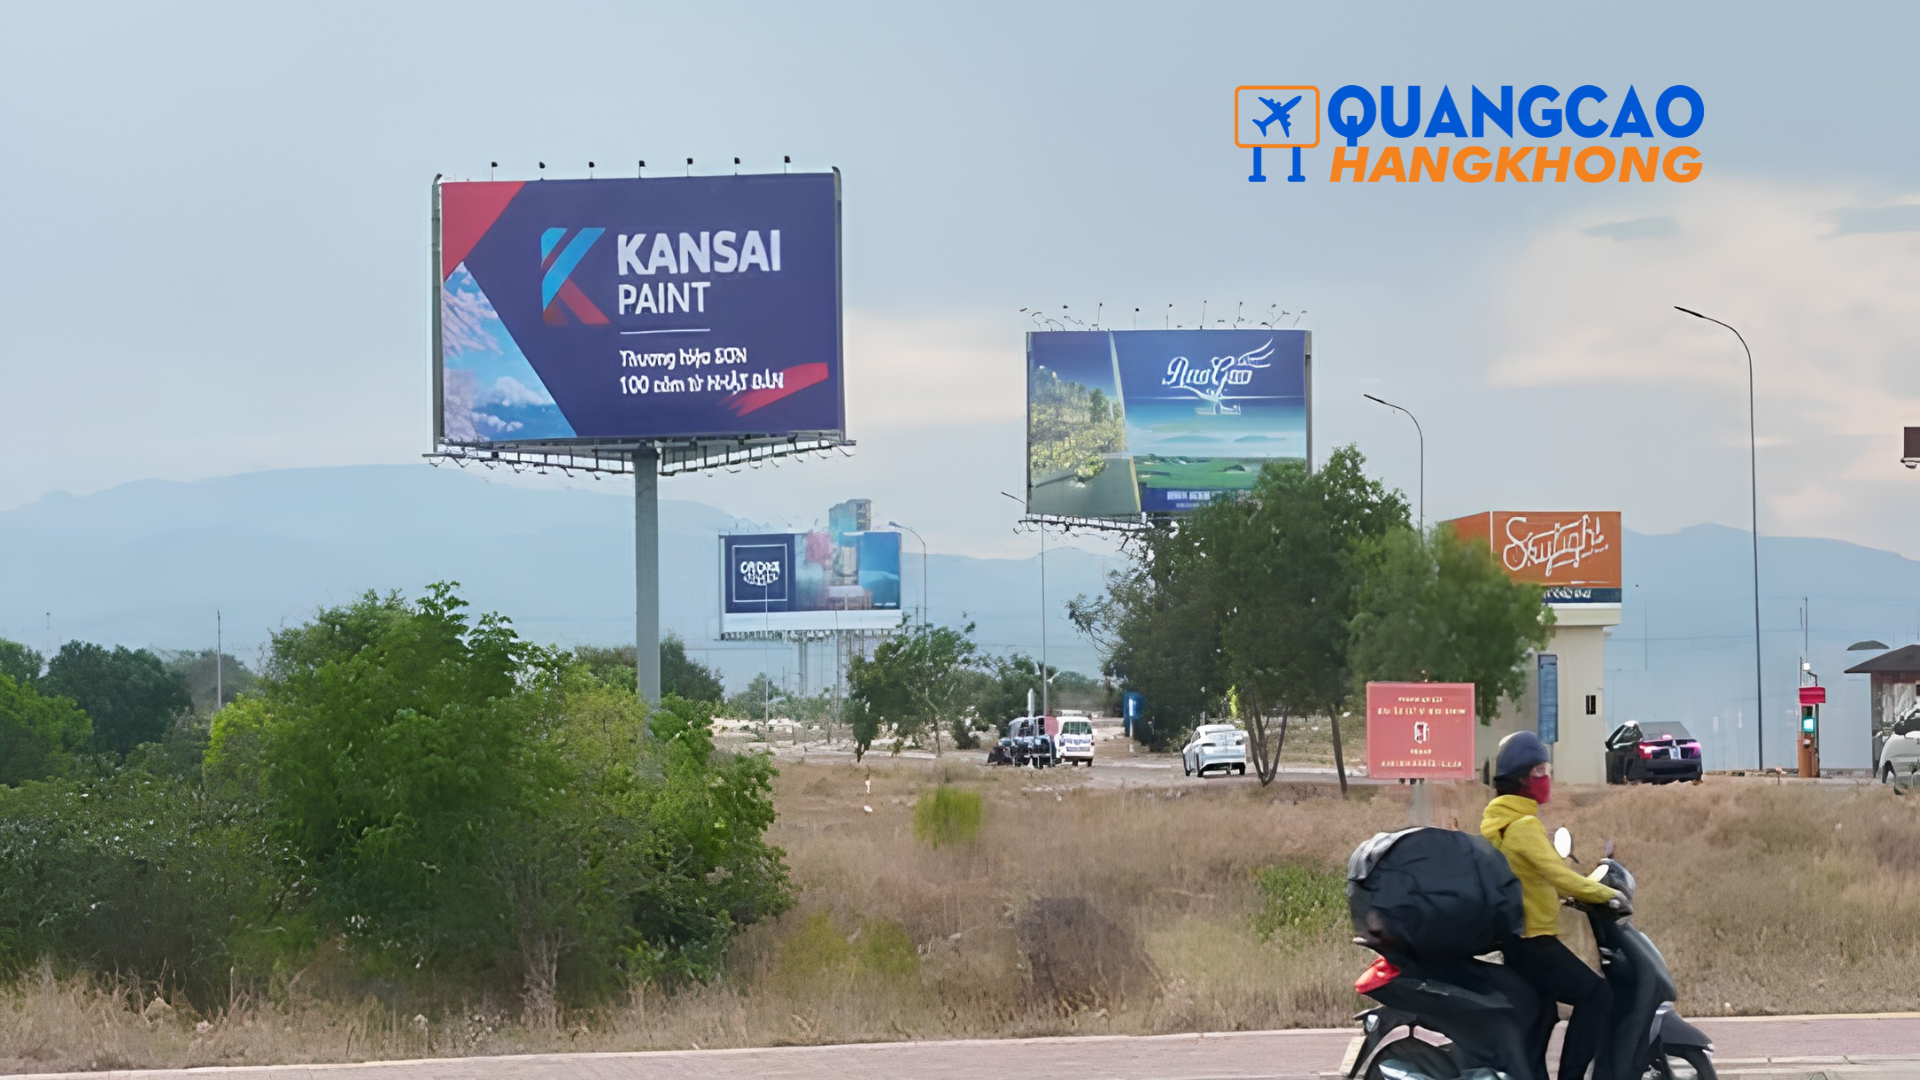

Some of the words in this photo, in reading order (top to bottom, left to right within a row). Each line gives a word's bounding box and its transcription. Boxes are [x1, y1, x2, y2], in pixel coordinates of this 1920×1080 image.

[617, 229, 781, 276] KANSAI
[618, 281, 711, 315] PAINT
[620, 375, 650, 395] 100
